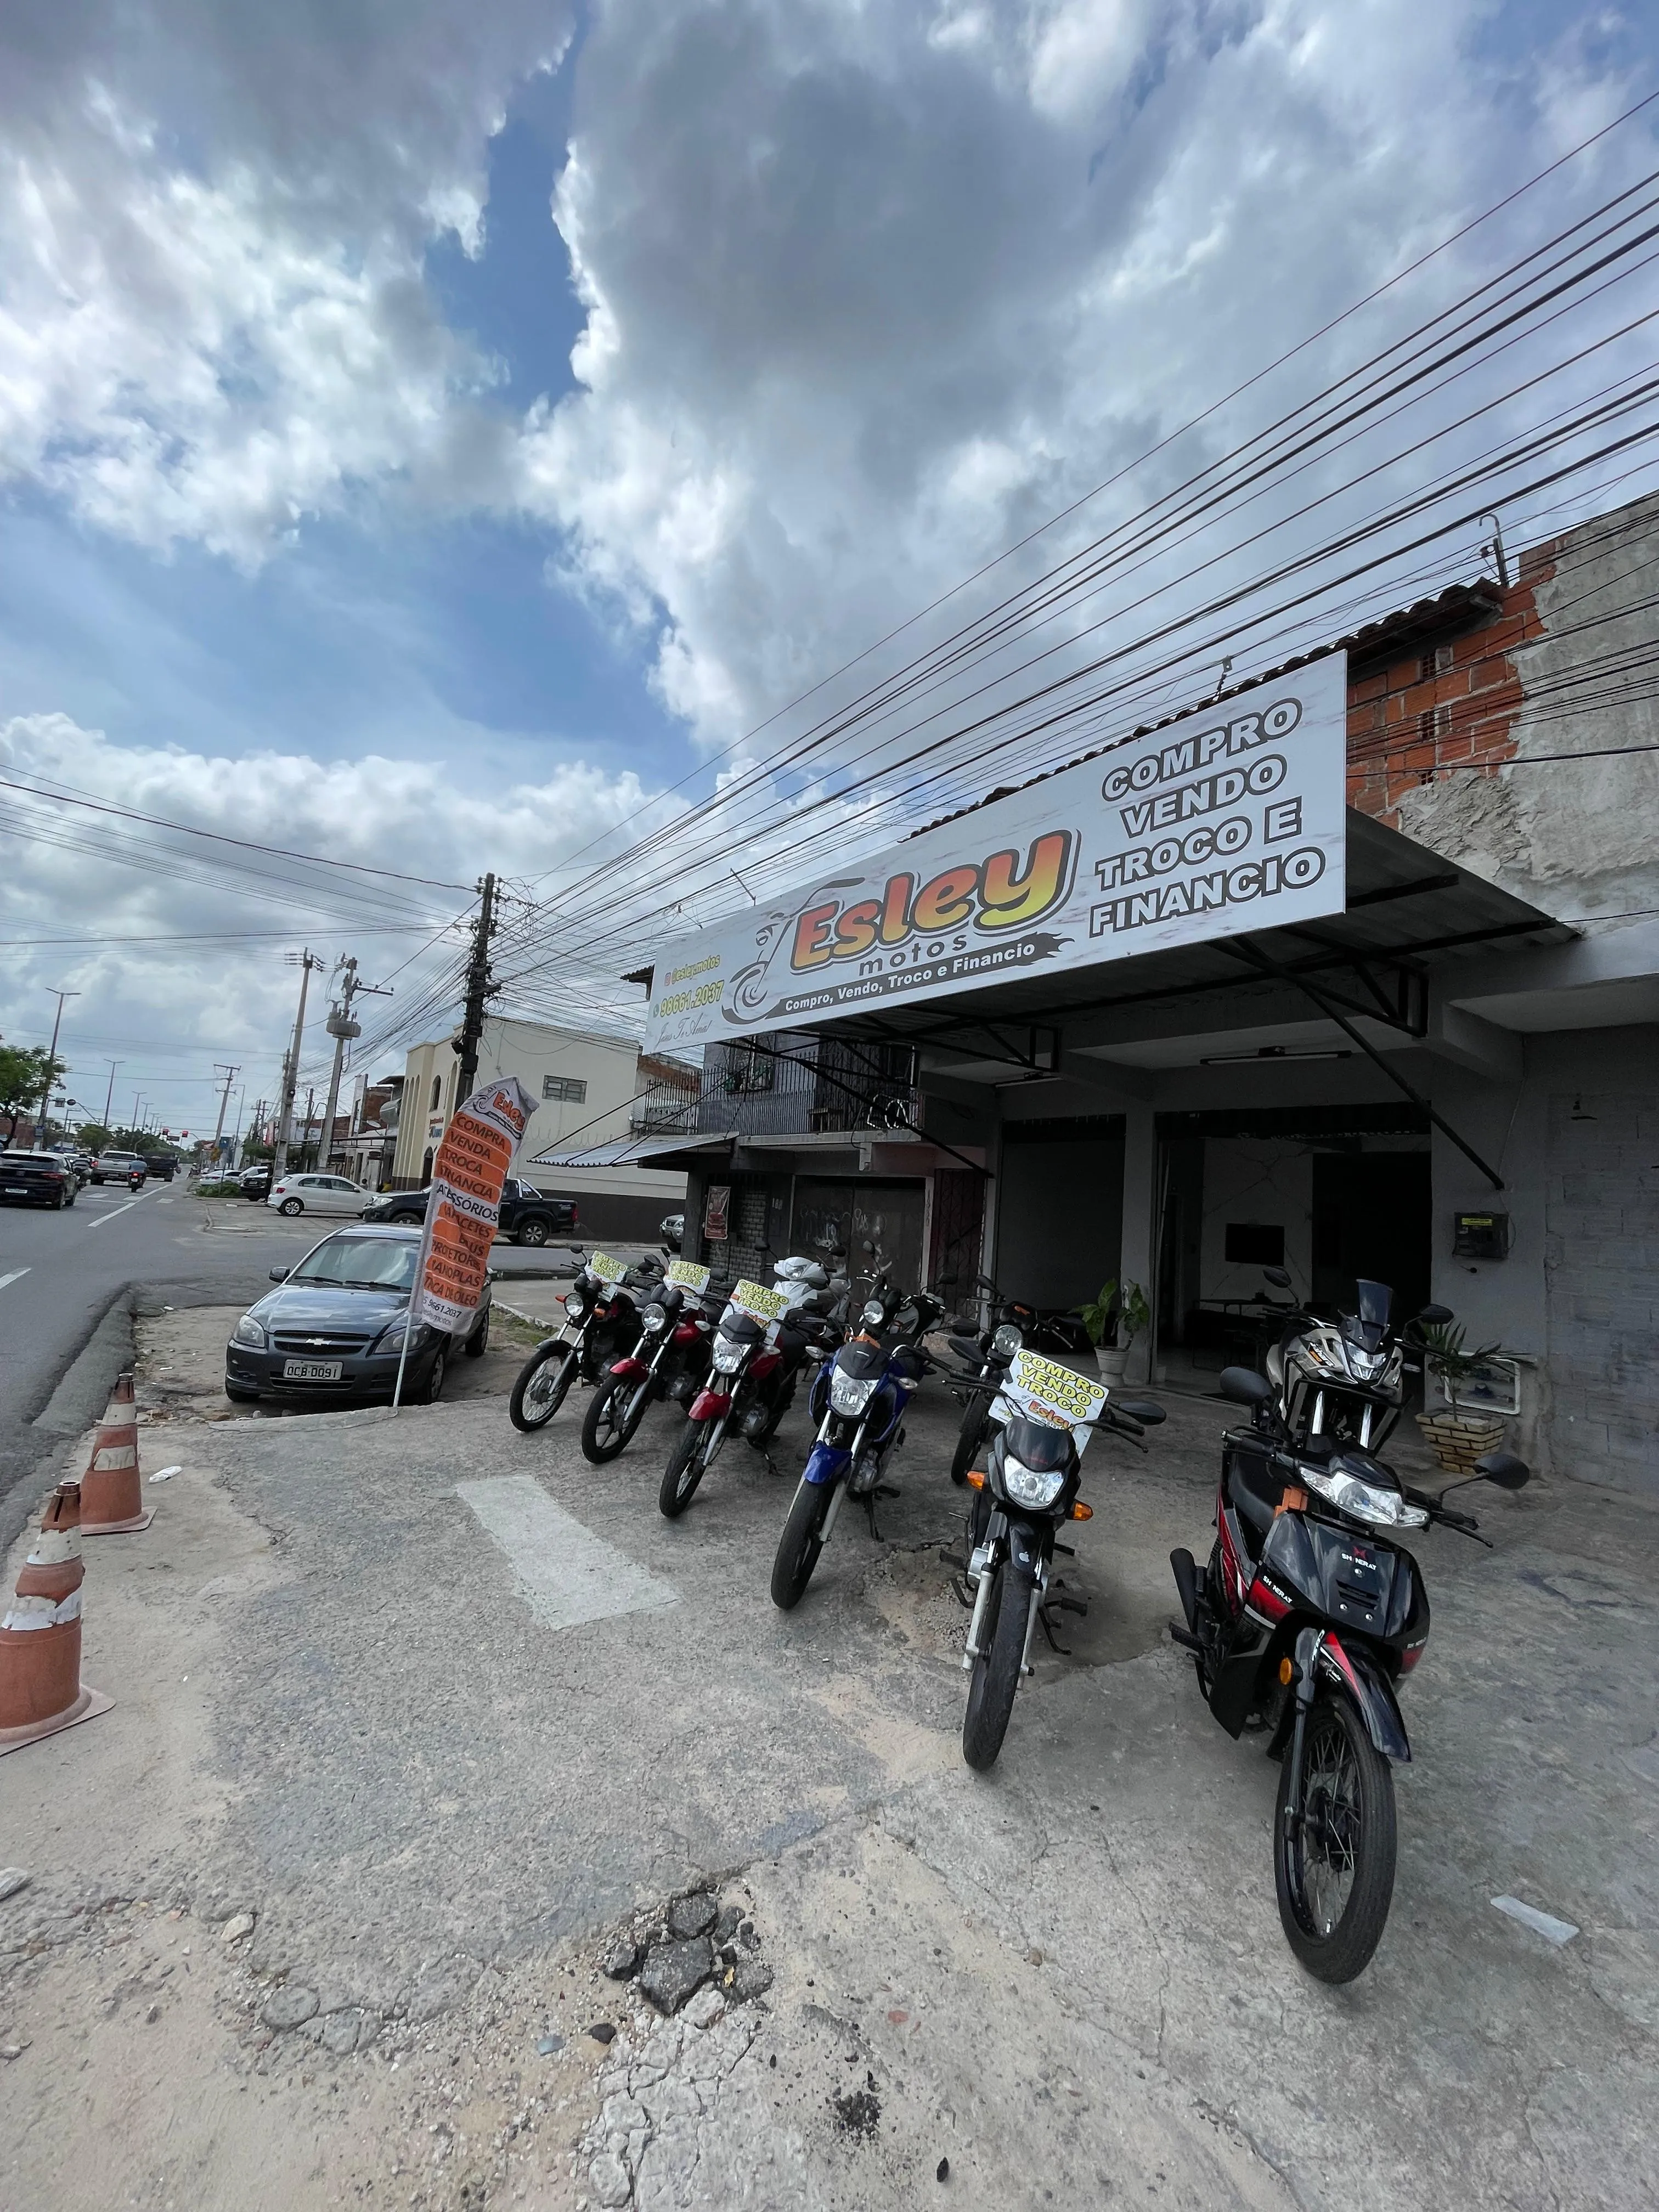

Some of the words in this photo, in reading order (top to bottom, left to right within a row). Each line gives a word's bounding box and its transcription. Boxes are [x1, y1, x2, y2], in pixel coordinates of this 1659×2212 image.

[1102, 697, 1302, 802] COMPRO
[1120, 754, 1286, 838] VENDO
[1094, 816, 1252, 891] TROCO
[1264, 796, 1302, 845] E
[790, 829, 1074, 973] Esley
[1089, 847, 1326, 938] FINANCIO
[859, 935, 968, 976] motos
[785, 992, 833, 1012] Compro,
[838, 981, 883, 1000] Vendo,
[888, 968, 932, 989] Troco
[937, 966, 947, 977] e
[952, 943, 1036, 974] Financio
[450, 1131, 490, 1160] VENDA
[456, 1116, 505, 1150] COMPRA
[445, 1148, 483, 1176] TROCA
[437, 1184, 498, 1222] AESSÓRIOS
[737, 1296, 777, 1318] TROCO
[739, 1280, 789, 1305] COMPRO
[741, 1289, 781, 1310] VENDO
[1018, 1351, 1105, 1398] COMPRO
[1022, 1364, 1091, 1406] VENDO
[1017, 1375, 1086, 1418] TROCO
[1341, 1553, 1377, 1571] SHNERAY
[1263, 1576, 1293, 1603] SHNERAY
